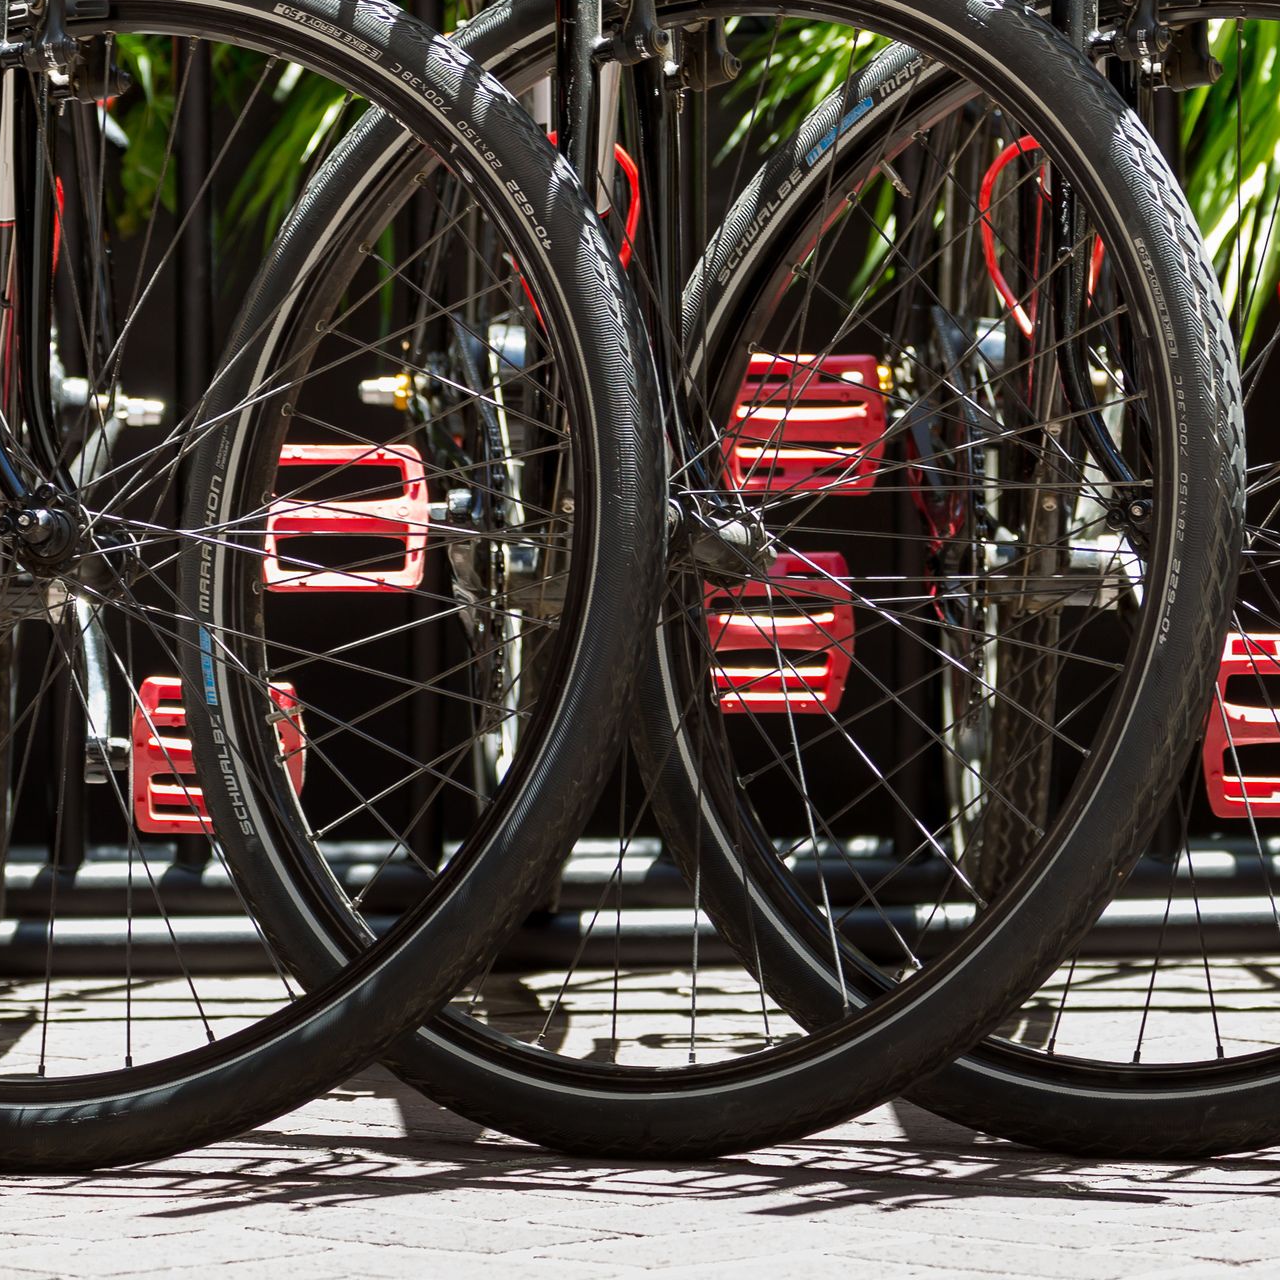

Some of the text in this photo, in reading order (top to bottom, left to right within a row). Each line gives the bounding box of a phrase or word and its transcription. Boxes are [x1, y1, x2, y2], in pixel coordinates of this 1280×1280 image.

[343, 34, 381, 60] E-BIKE
[505, 179, 552, 250] 40-622
[717, 165, 804, 288] SCHWALBE
[198, 474, 223, 614] MARAHON
[1158, 558, 1181, 645] 40-622
